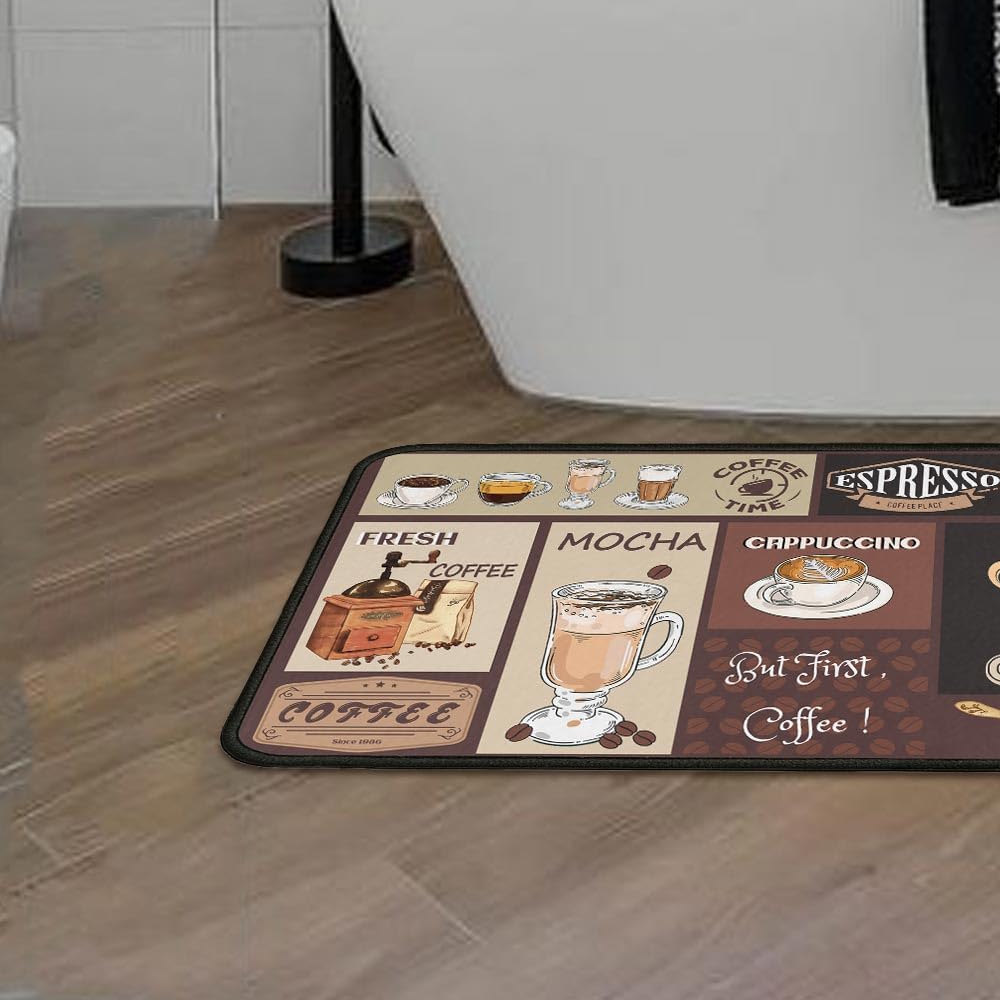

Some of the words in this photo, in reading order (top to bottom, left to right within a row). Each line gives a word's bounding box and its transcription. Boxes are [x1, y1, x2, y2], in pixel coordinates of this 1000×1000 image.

[713, 458, 809, 480] COFFEE
[834, 462, 1000, 499] ESPRESSO
[724, 499, 785, 513] TIME
[356, 531, 459, 546] FRESH
[557, 531, 707, 551] MOCHA
[743, 536, 921, 550] CAPPUCCINO
[429, 563, 518, 578] COFFEE
[724, 651, 790, 686] But
[278, 701, 461, 724] COFFEE
[743, 706, 848, 745] Coffee
